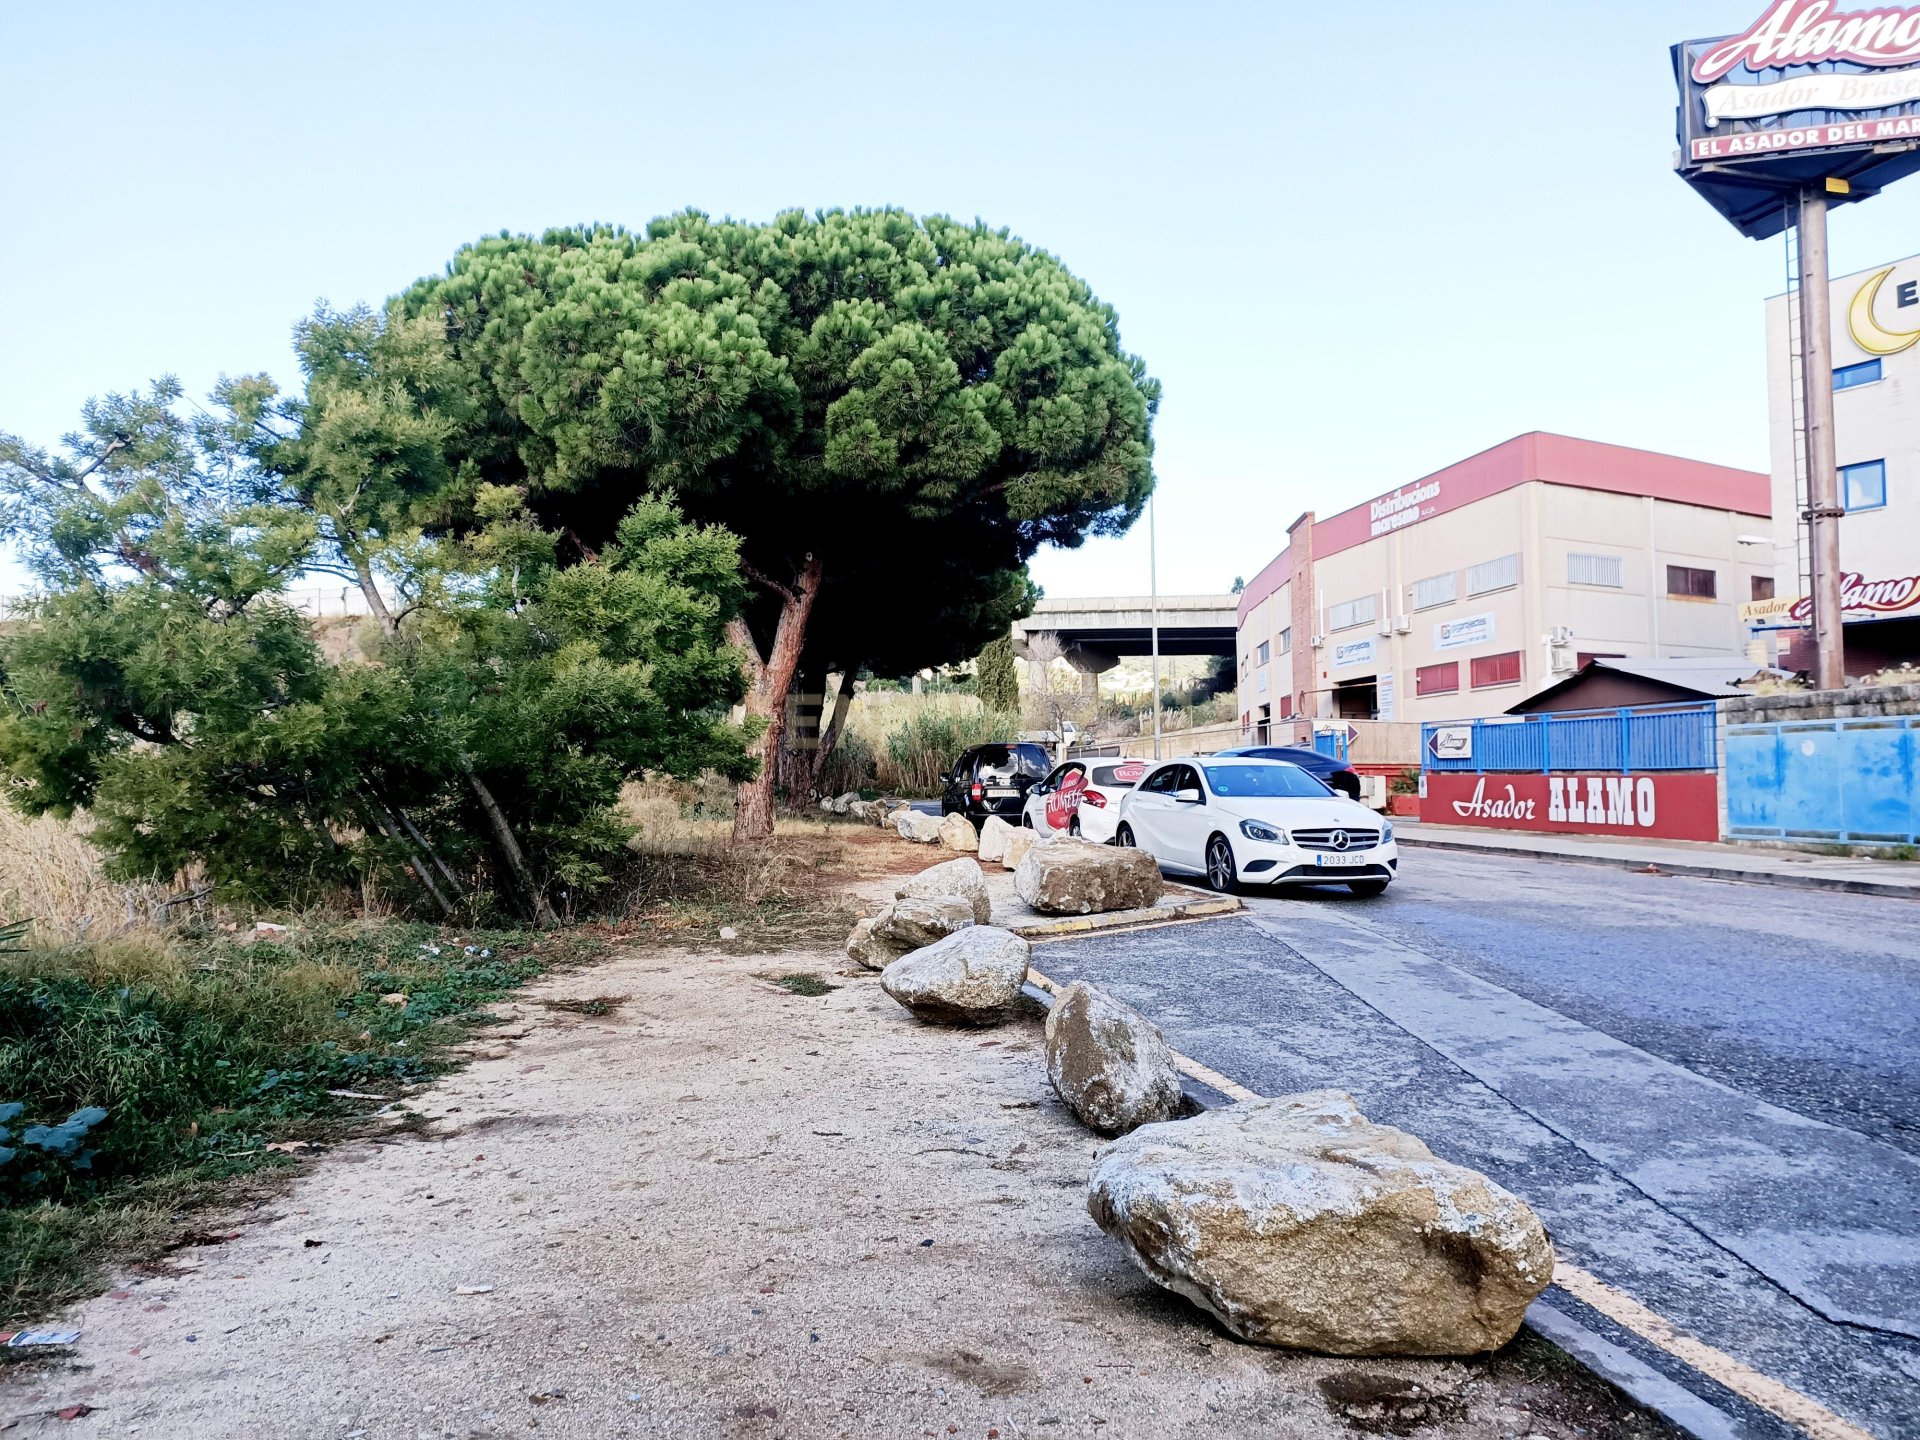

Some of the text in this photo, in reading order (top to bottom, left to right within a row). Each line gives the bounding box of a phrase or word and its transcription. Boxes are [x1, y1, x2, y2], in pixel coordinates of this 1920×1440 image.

[1717, 77, 1920, 113] Asador Brase
[1699, 141, 1721, 157] EL
[1728, 130, 1820, 154] ASADOR
[1827, 124, 1868, 142] DEL
[1743, 602, 1788, 616] Asador
[1452, 777, 1656, 828] Asador ALAMO
[1323, 855, 1346, 865] 2033
